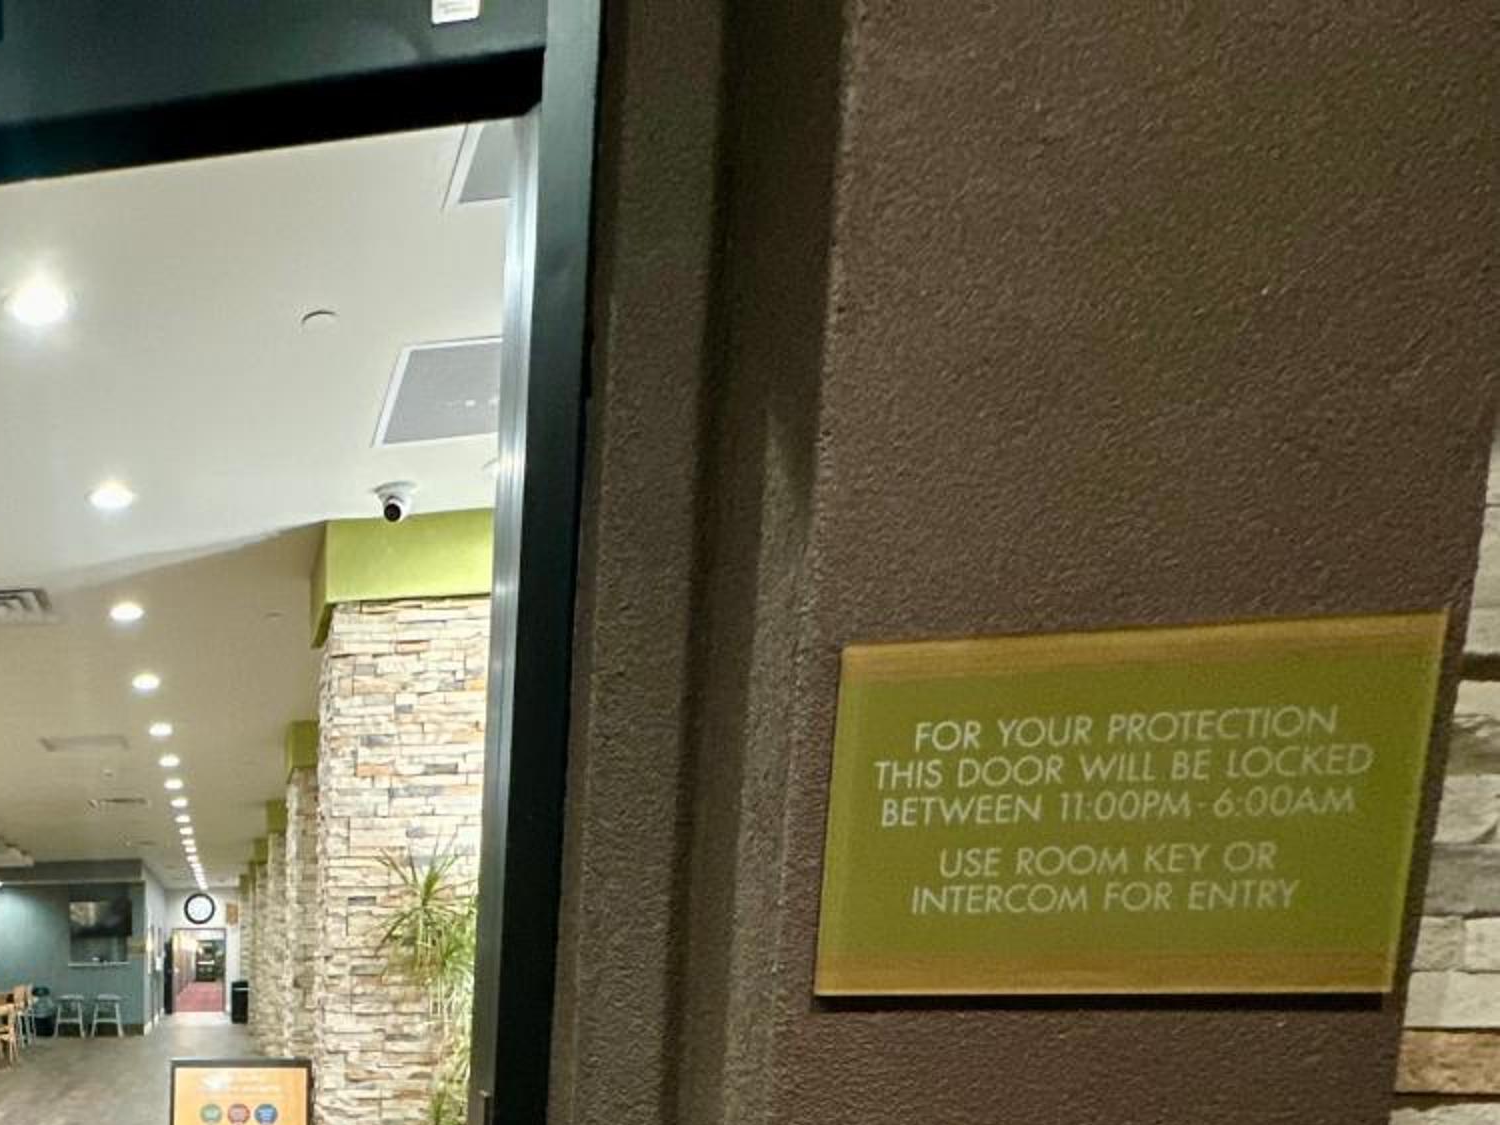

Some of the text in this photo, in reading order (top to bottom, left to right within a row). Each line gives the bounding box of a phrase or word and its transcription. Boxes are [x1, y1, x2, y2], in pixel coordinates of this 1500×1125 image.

[915, 704, 1338, 751] FOR YOUR PROTECTION
[874, 743, 1374, 790] THIS DOOR WILL BE LOCKED
[881, 794, 1043, 828] BETWEEN
[1059, 788, 1191, 821] 11:00PM
[1213, 784, 1356, 817] 6:00AM
[939, 841, 1278, 878] USE ROOM KEY OR
[911, 879, 1300, 913] INTERCOM FOR ENTRY
